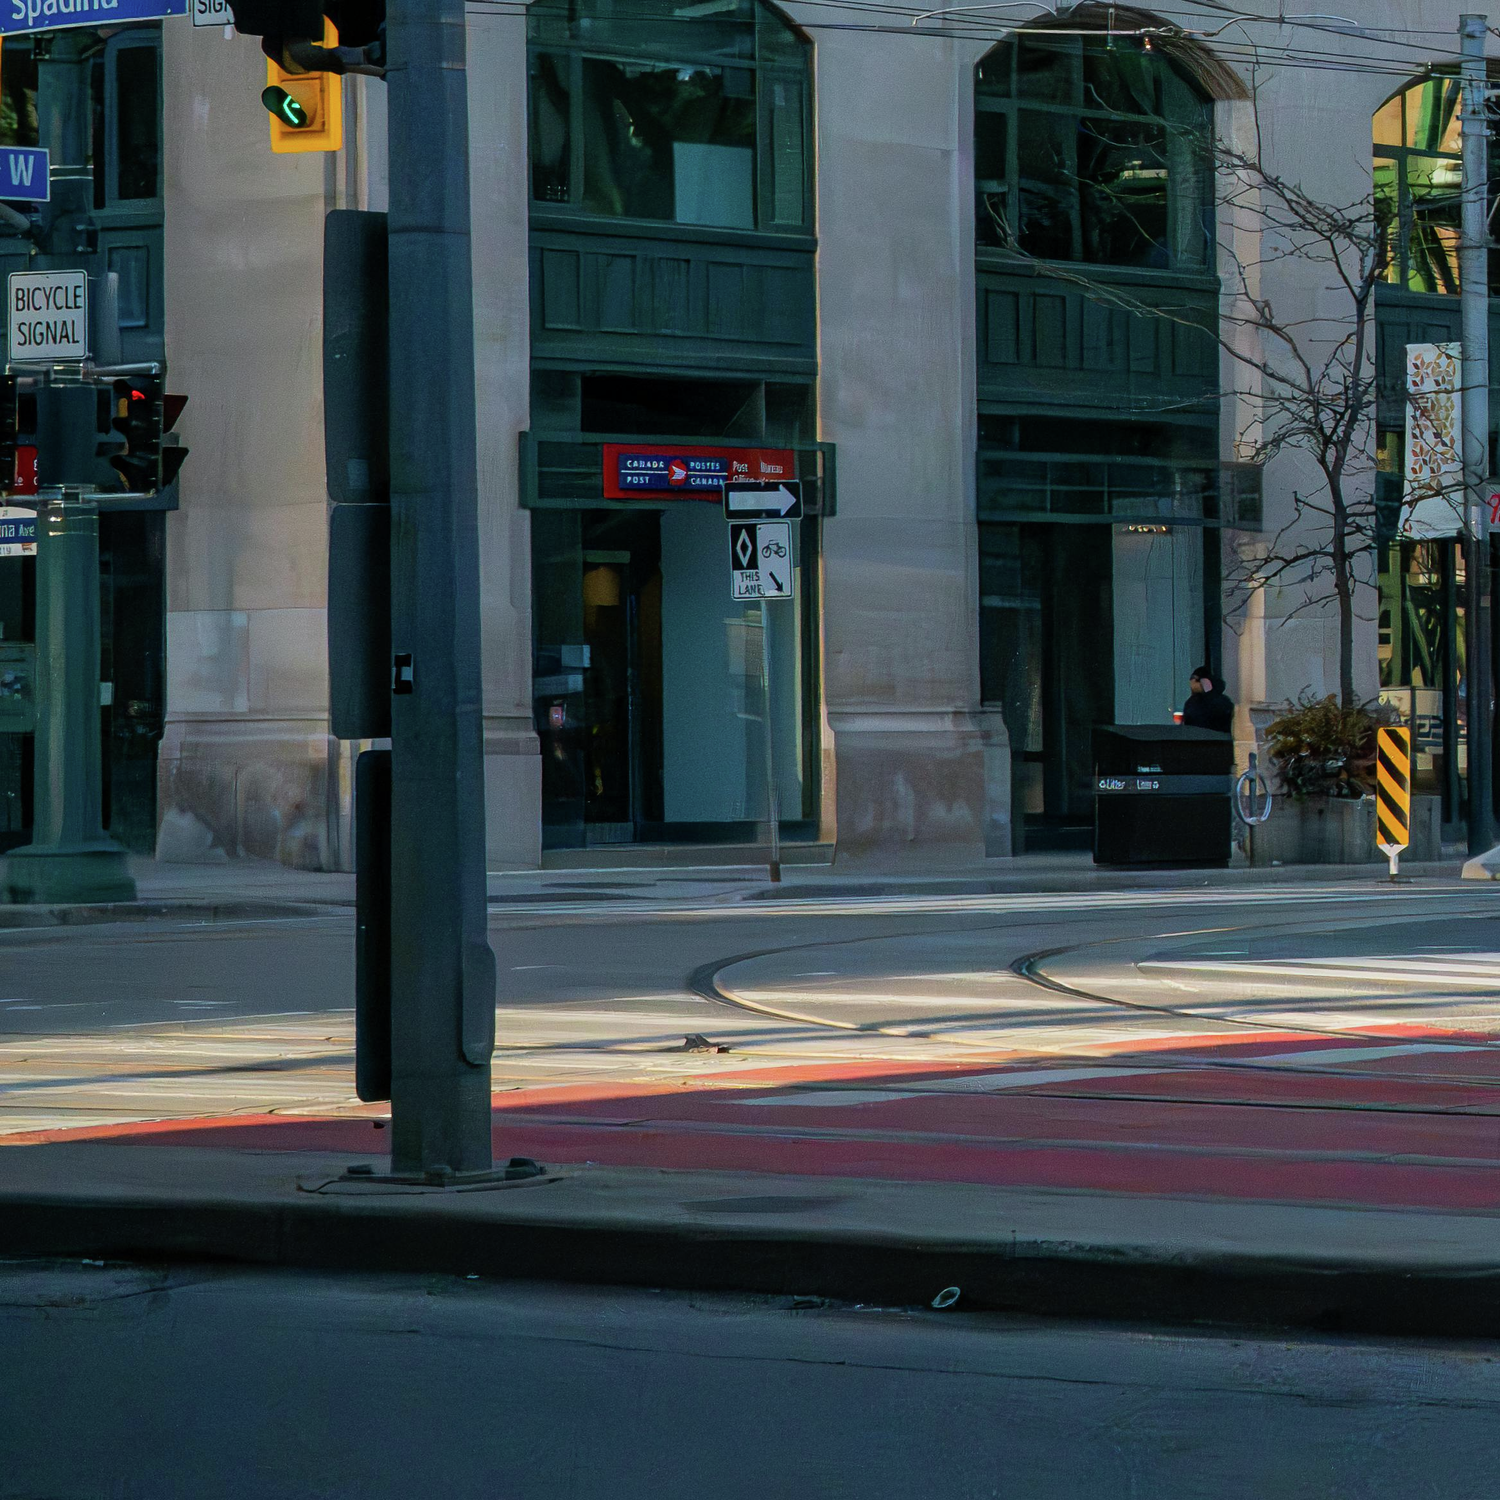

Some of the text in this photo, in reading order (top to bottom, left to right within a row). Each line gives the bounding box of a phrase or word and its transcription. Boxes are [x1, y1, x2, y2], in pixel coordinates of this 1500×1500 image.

[9, 154, 34, 186] W
[15, 285, 83, 312] BICYCLE
[17, 320, 80, 346] SIGNAL
[626, 460, 665, 468] CANADA
[689, 461, 720, 470] POSTES
[626, 476, 650, 484] POST
[690, 477, 724, 486] CANADA
[18, 523, 35, 537] Ave
[740, 571, 760, 582] THIS
[738, 583, 765, 596] LANE
